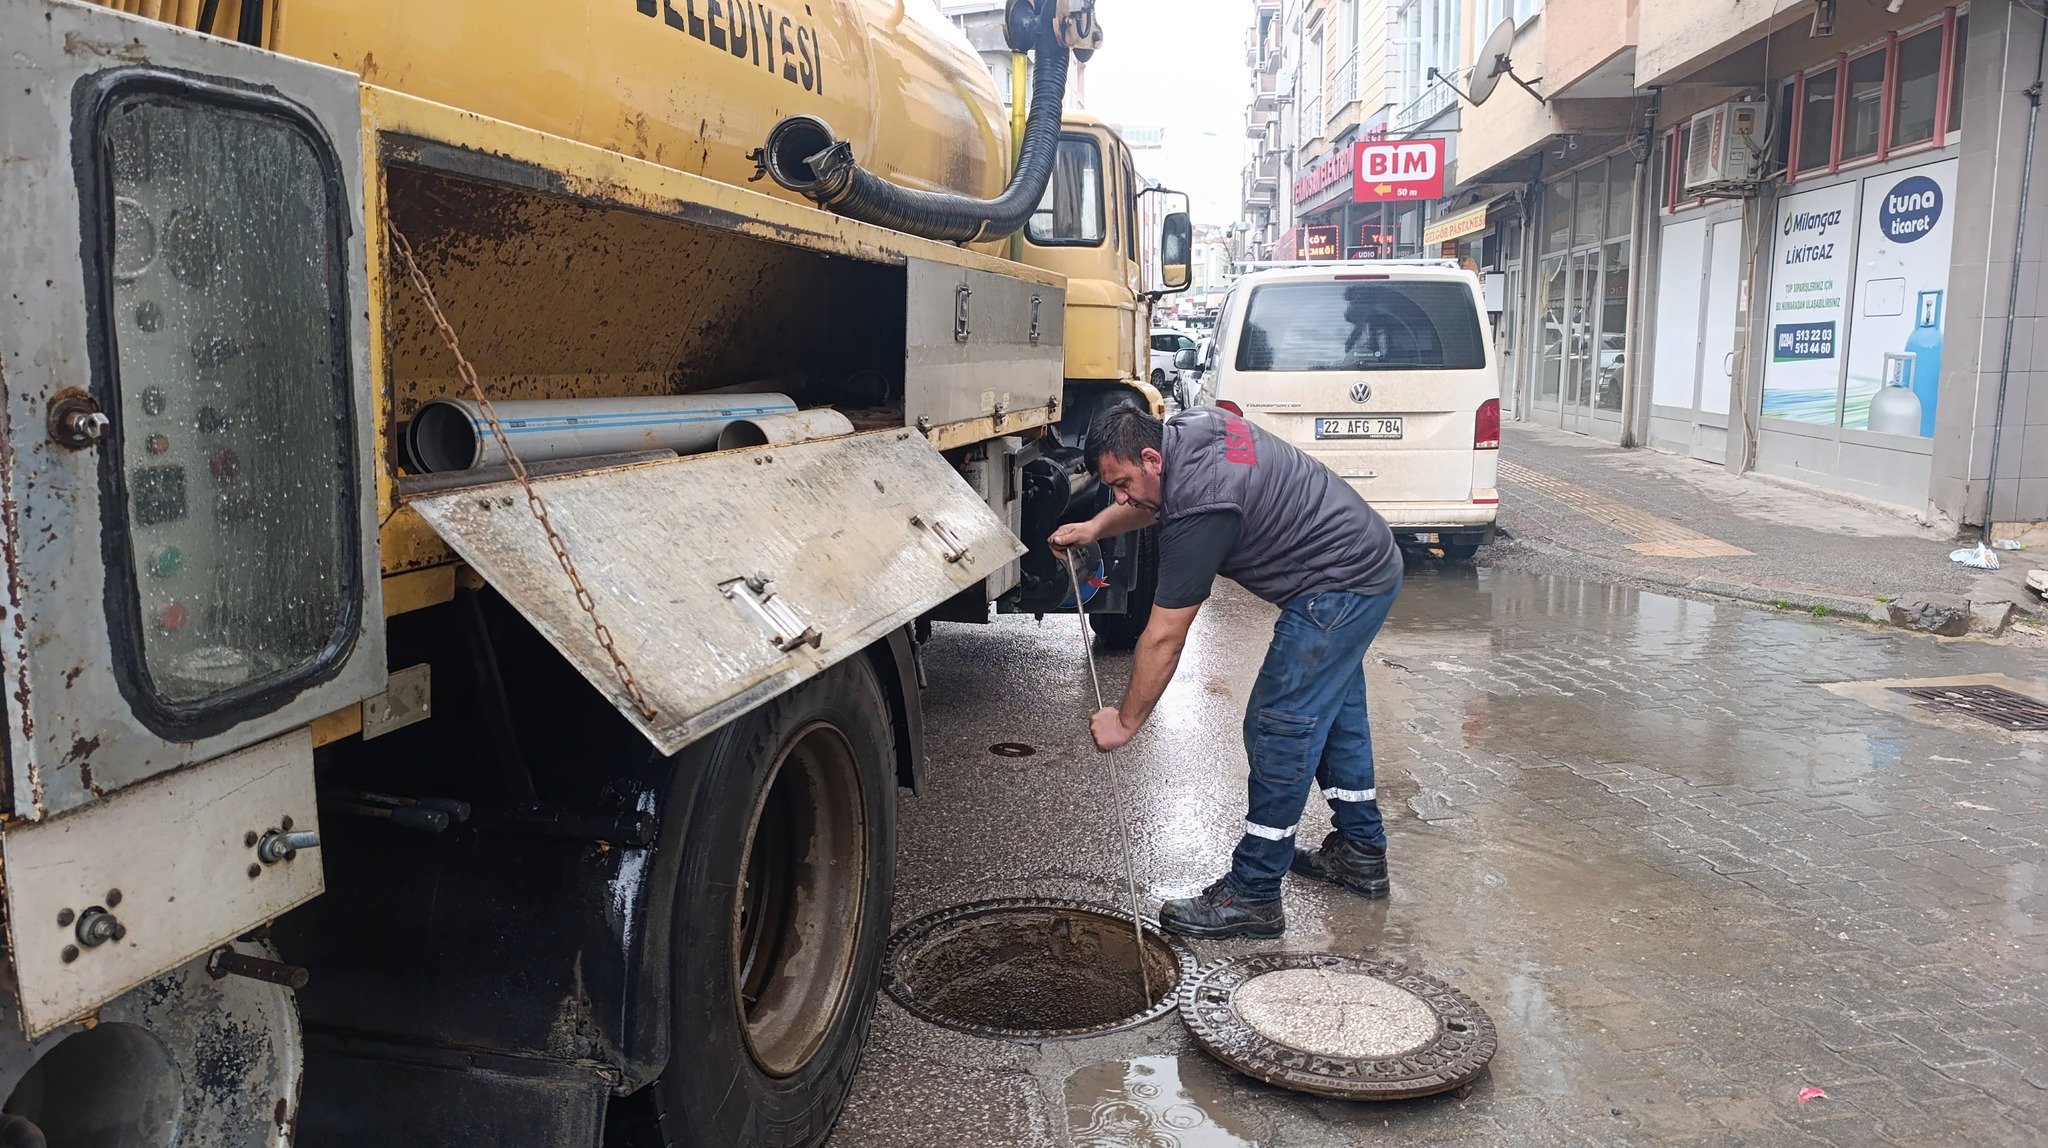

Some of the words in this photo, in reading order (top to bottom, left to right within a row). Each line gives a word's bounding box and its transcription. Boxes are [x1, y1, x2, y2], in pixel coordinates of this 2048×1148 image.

[1397, 188, 1408, 197] 50
[1889, 191, 1935, 214] tuna
[1793, 210, 1841, 236] Milangaz
[1891, 215, 1930, 235] ticaret
[1298, 244, 1335, 257] EMEĞİ
[1786, 243, 1834, 265] LİKİTGAZ
[1796, 330, 1809, 341] 513
[1811, 329, 1820, 341] 22
[1822, 329, 1832, 341] 03
[1795, 343, 1808, 353] 513
[1810, 342, 1819, 353] 44
[1821, 342, 1831, 354] 60
[1325, 420, 1339, 433] 22
[1348, 420, 1369, 433] AFG
[1377, 420, 1400, 433] 784
